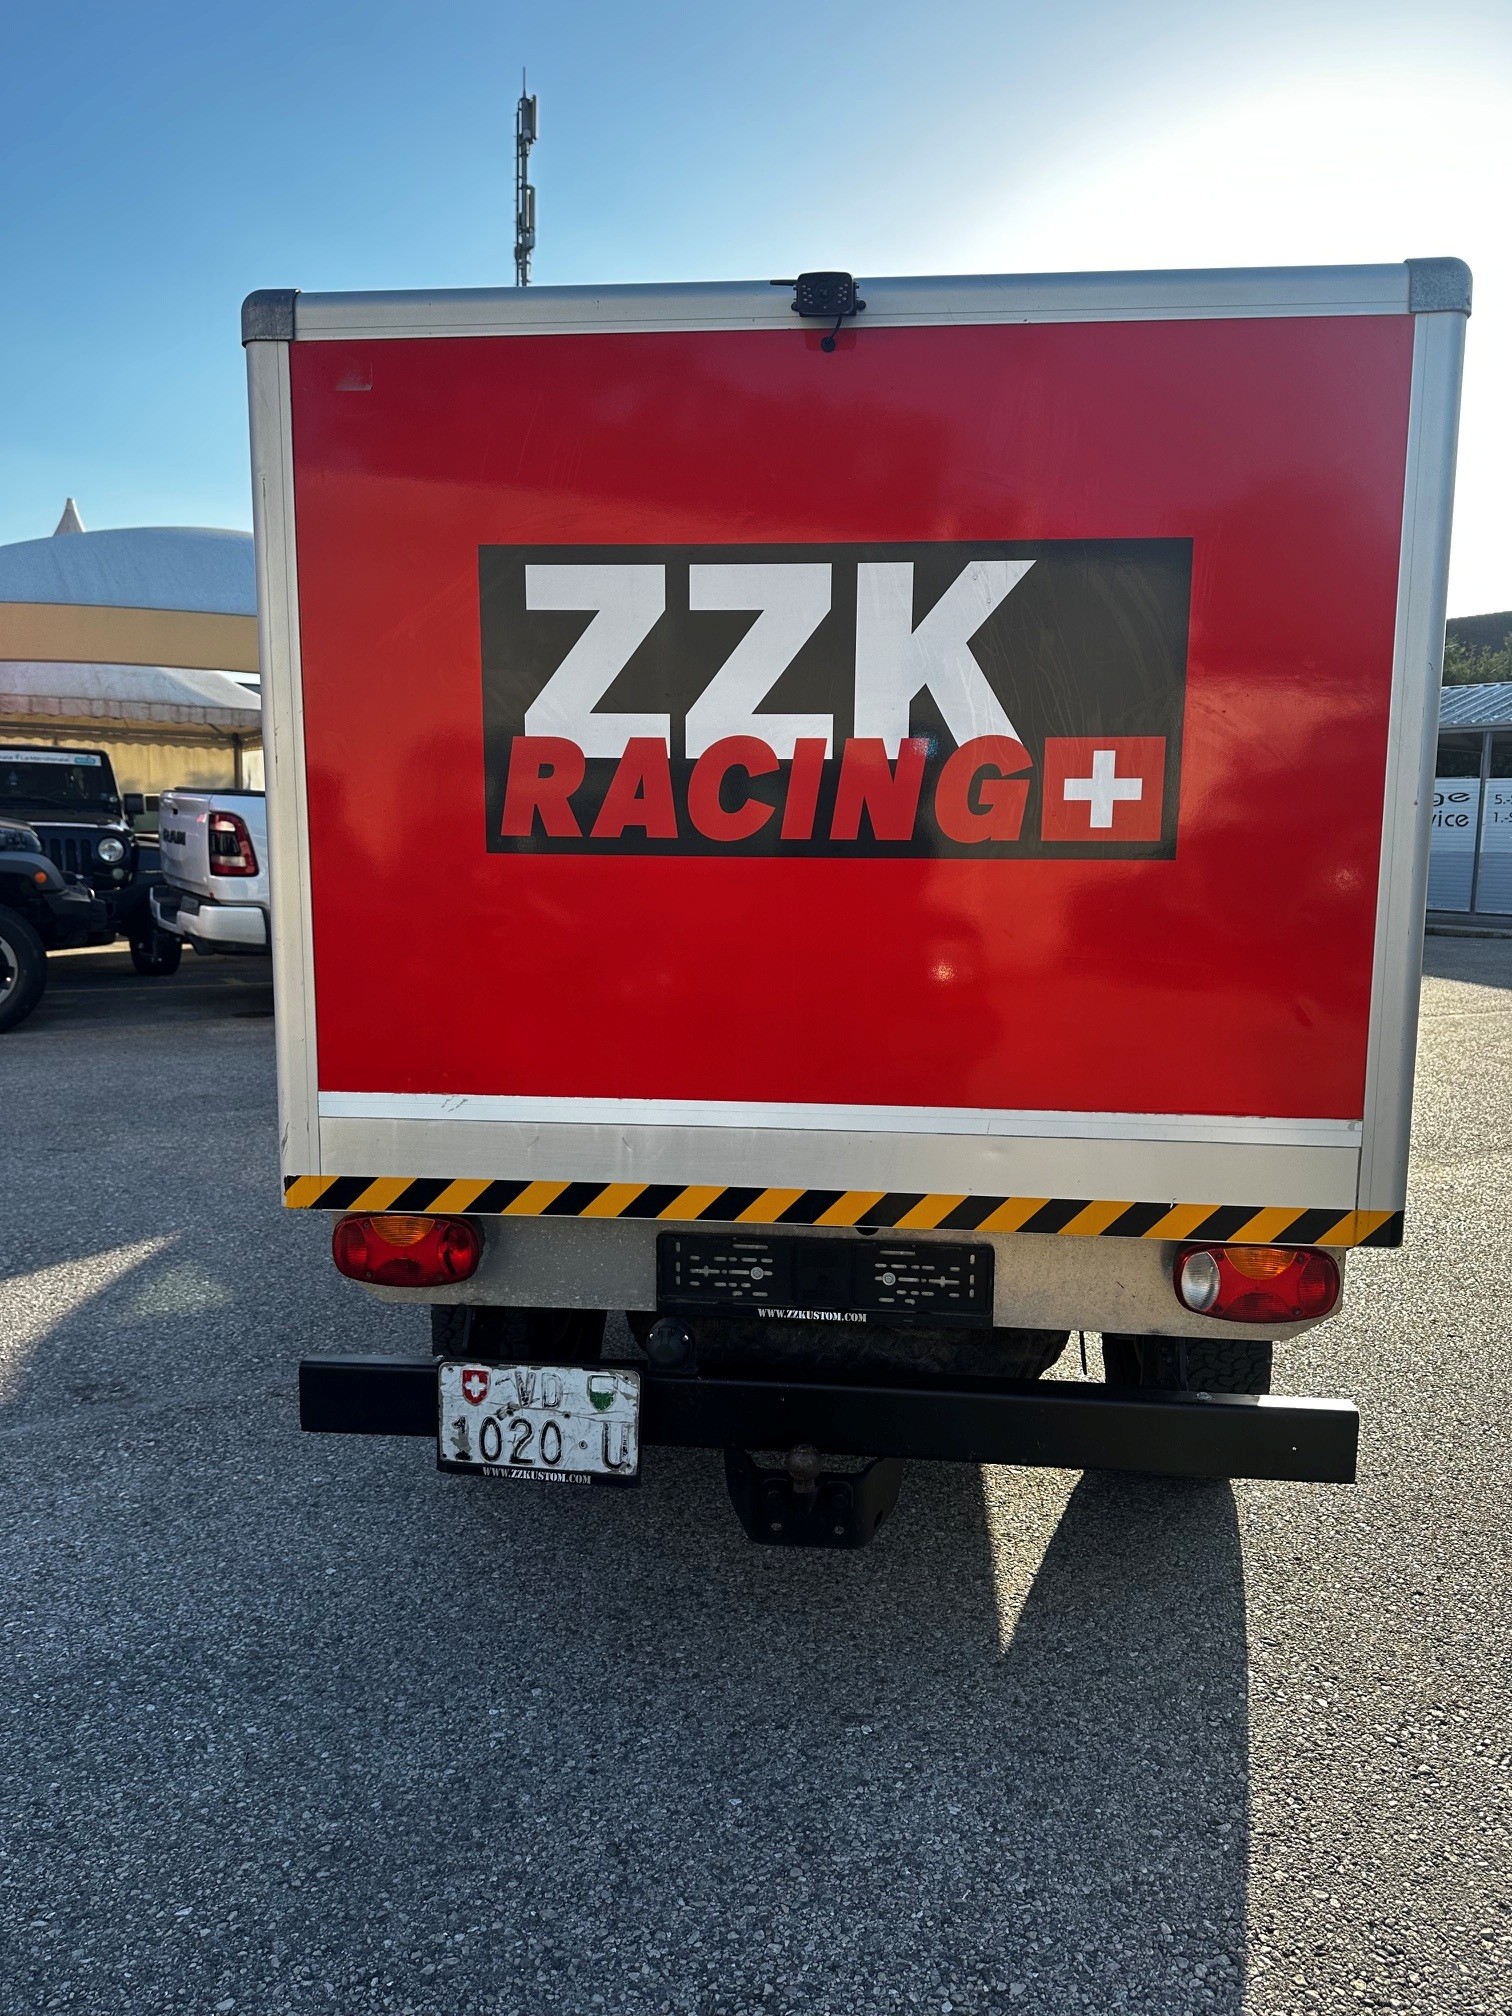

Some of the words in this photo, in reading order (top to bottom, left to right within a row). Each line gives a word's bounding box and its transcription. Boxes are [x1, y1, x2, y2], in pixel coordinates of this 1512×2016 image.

[523, 560, 1037, 758] ZZK
[501, 734, 1034, 843] RACING
[163, 828, 186, 846] RAM
[757, 1308, 867, 1322] WWW.ZZKUSTOM.COM
[514, 1370, 564, 1408] VD
[601, 1421, 631, 1470] U
[482, 1466, 592, 1484] WWW.ZZKUSTOM.COM
